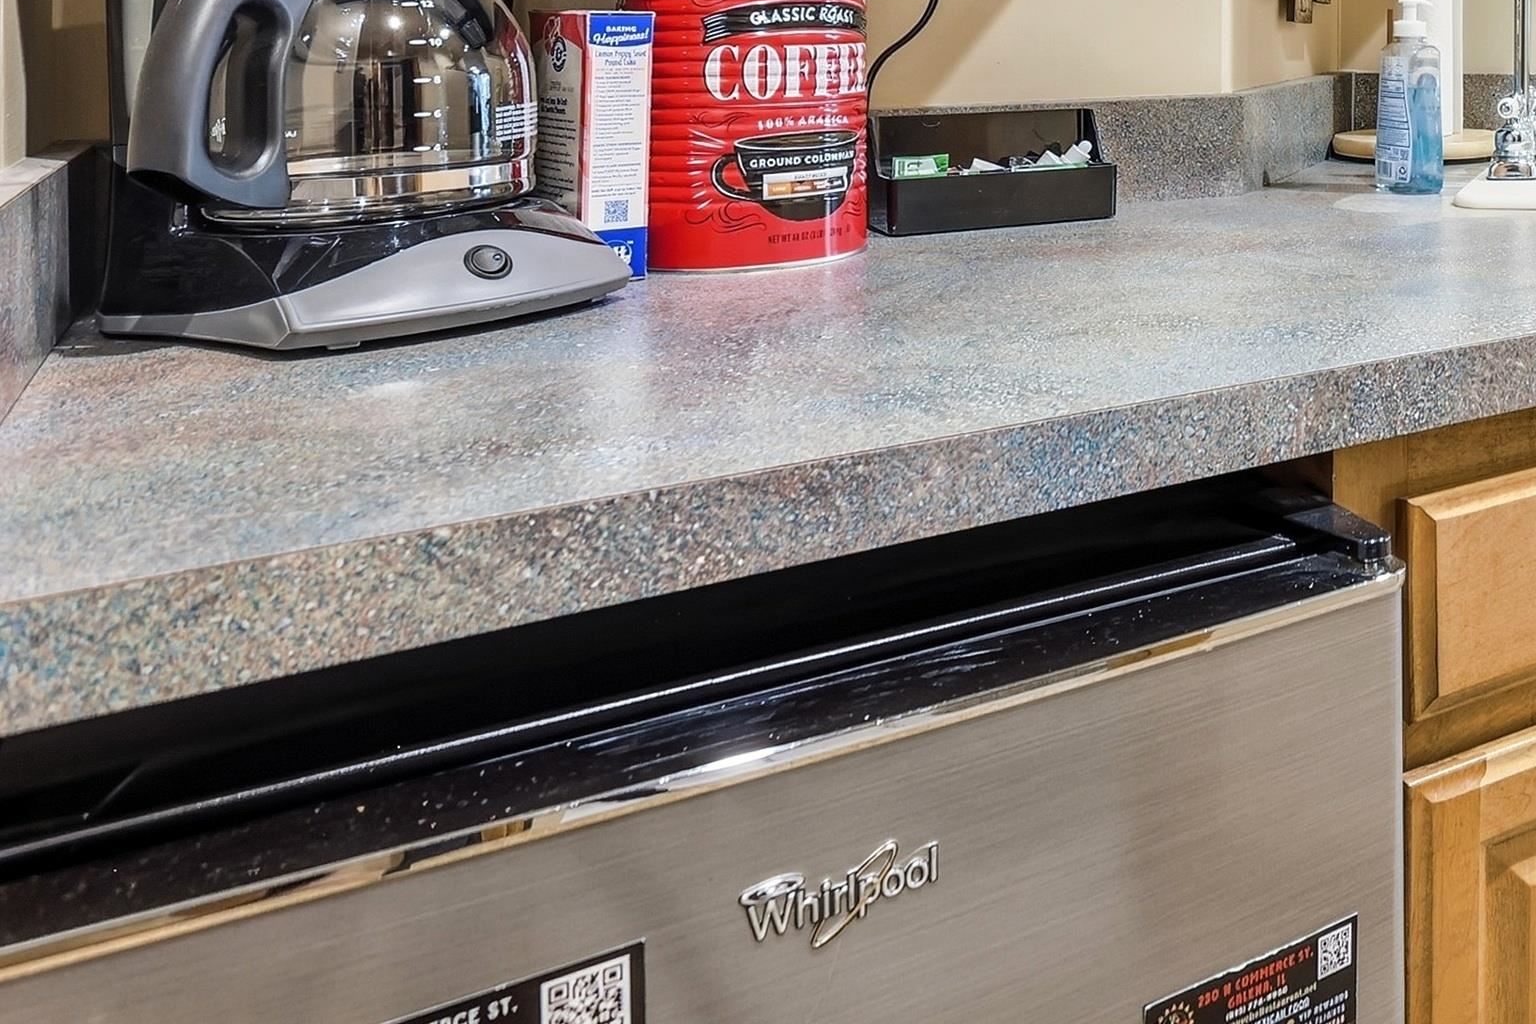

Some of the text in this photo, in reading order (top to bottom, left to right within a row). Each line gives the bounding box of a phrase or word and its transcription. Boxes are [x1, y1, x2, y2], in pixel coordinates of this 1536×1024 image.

[420, 0, 434, 8] 12
[749, 5, 854, 25] CLASSIC ROAST
[428, 37, 443, 47] 10
[592, 27, 650, 45] Happiness!
[433, 75, 442, 84] 8
[433, 109, 442, 118] 6
[757, 114, 849, 131] 100% ARABICA
[432, 143, 442, 152] 4
[749, 156, 802, 168] GROUND
[745, 840, 940, 942] Whirlpool
[1235, 953, 1296, 990] COMMERCE
[487, 996, 518, 1021] ST.
